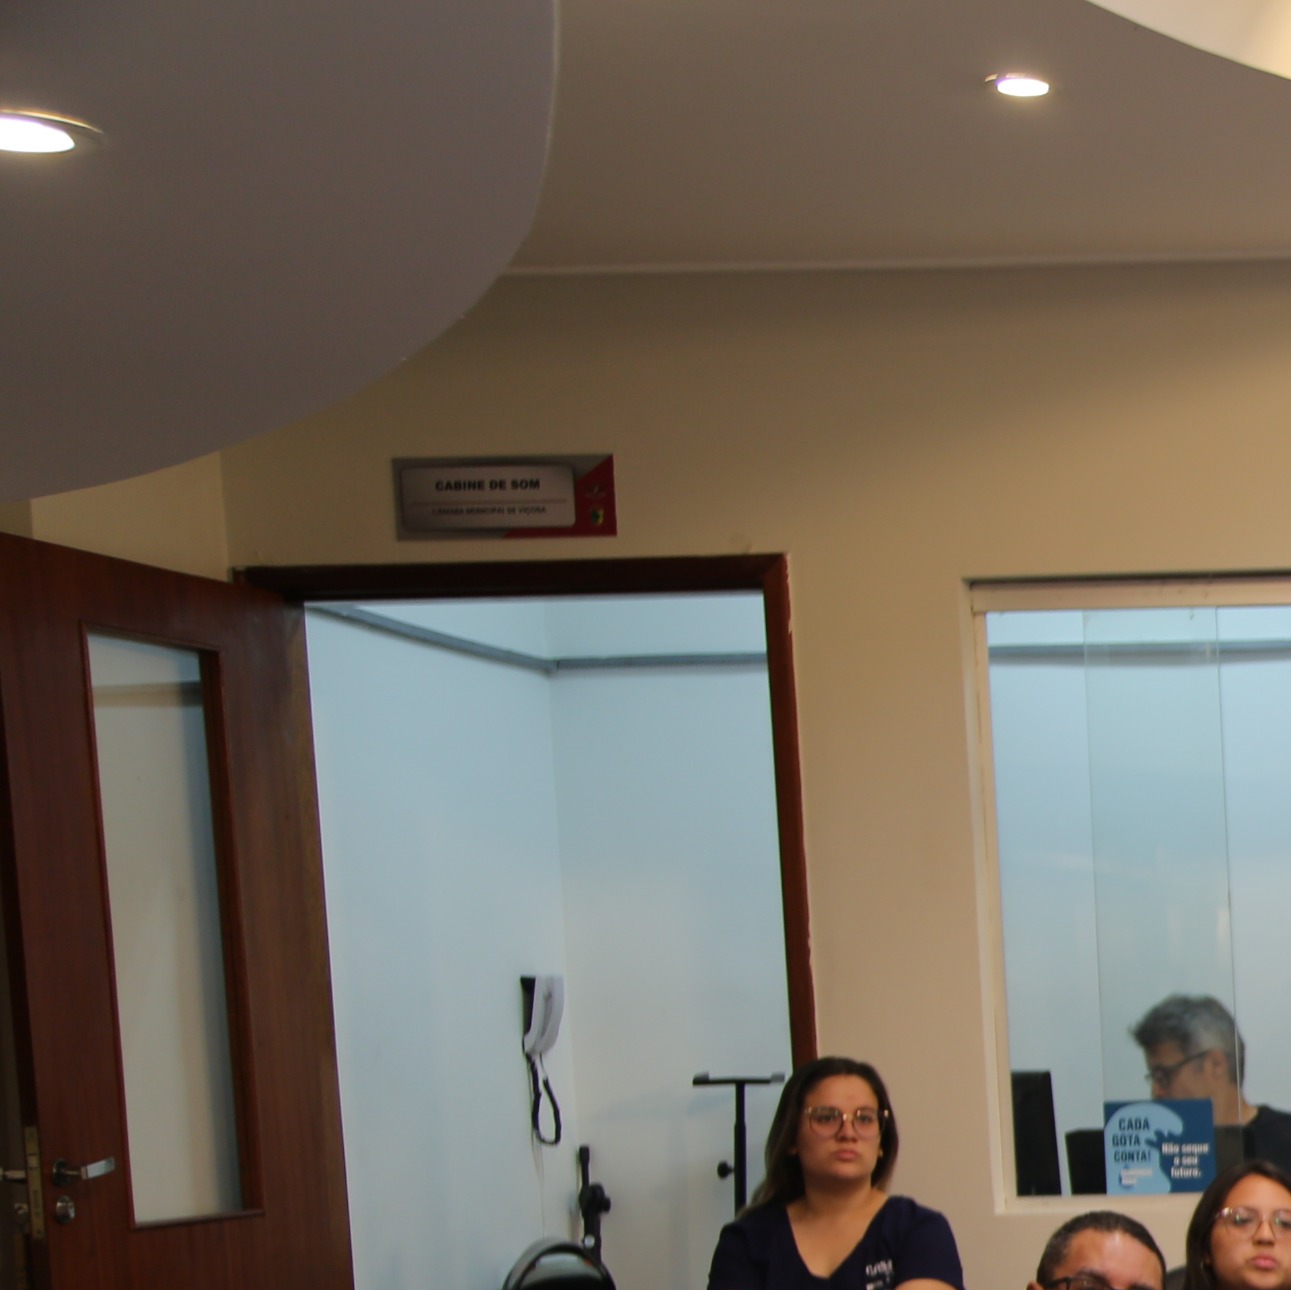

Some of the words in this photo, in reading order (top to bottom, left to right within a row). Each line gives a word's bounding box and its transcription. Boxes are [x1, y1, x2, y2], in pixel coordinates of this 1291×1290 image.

[435, 479, 485, 491] CABINE
[489, 479, 507, 491] DE
[511, 479, 541, 491] SOM
[1118, 1116, 1150, 1131] CADA
[1112, 1133, 1141, 1148] GOTA
[1162, 1141, 1180, 1154] Não
[1114, 1149, 1152, 1163] CONTA!
[1181, 1153, 1199, 1165] seu
[1171, 1165, 1202, 1179] futuro.
